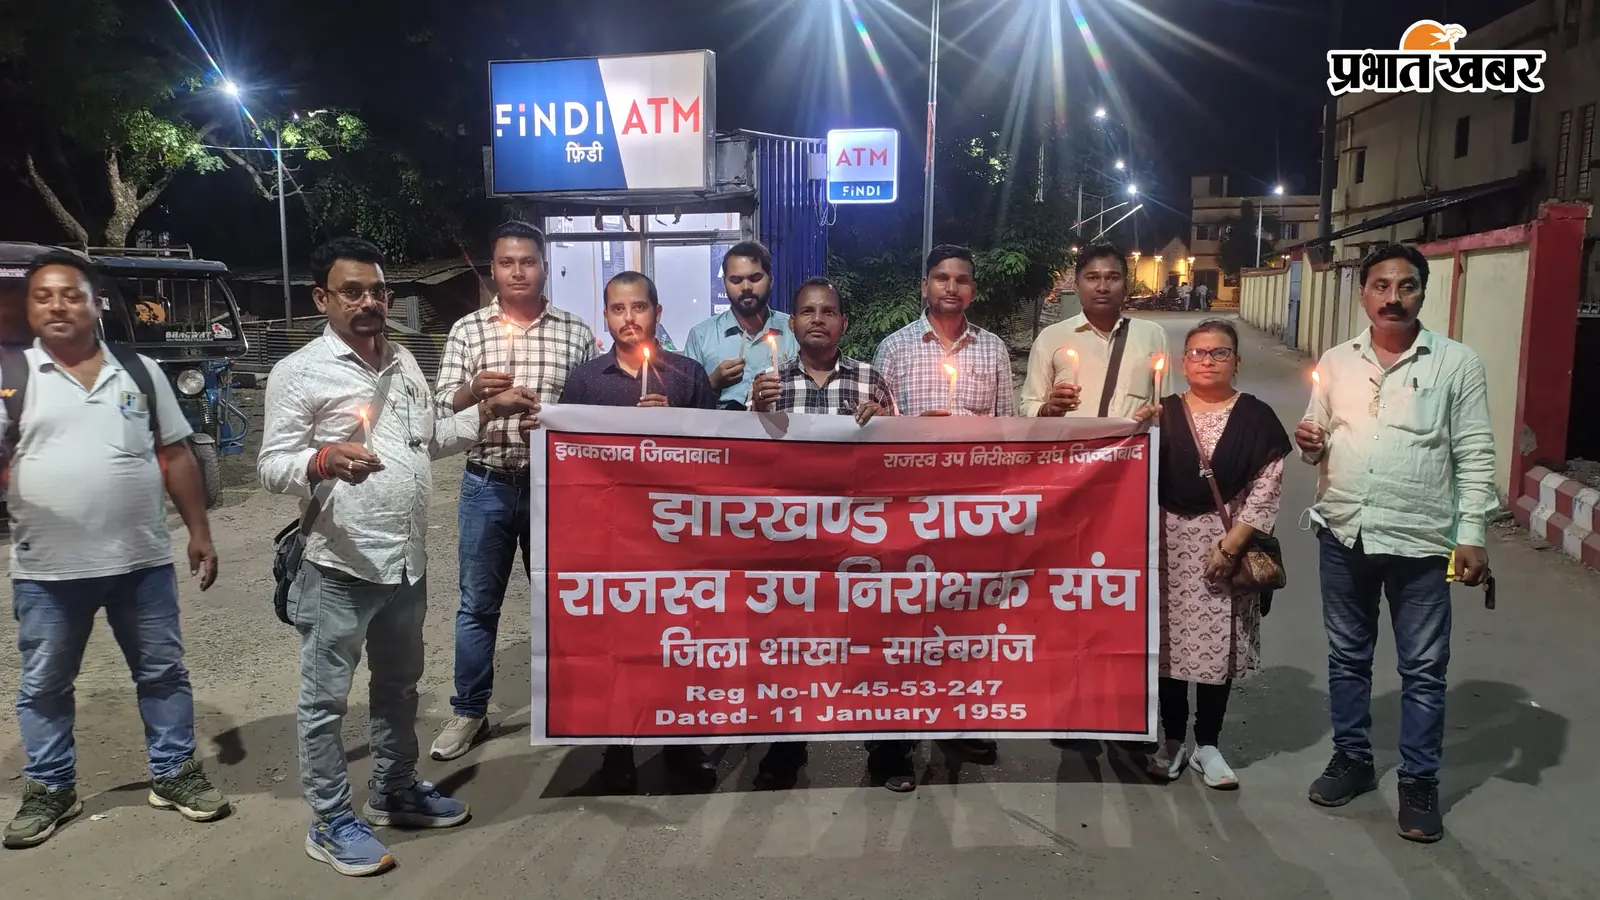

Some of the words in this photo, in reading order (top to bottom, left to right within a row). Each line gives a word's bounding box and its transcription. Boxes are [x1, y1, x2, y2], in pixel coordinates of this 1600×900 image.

[621, 96, 700, 135] ATM
[835, 147, 888, 166] ATM
[883, 452, 936, 468] राजस्व
[941, 452, 965, 467] उप
[969, 446, 1033, 466] निरीक्षक
[1037, 446, 1065, 465] संघ
[1069, 443, 1144, 465] जिन्दाबाद
[648, 492, 893, 544] झारखण्ड
[908, 494, 1042, 540] राज्य
[557, 570, 730, 616] राजस्व
[744, 571, 821, 614] उप
[834, 555, 1034, 614] निरीक्षक
[1048, 551, 1141, 612] संघ
[660, 626, 749, 669] जिला
[882, 623, 1036, 666] साहेबगंज
[686, 686, 745, 705] Reg
[757, 680, 1003, 700] No-IV-45-53-247
[655, 707, 758, 725] Dated-
[770, 706, 803, 723] 11
[816, 705, 941, 724] January
[953, 703, 1028, 720] 1955
